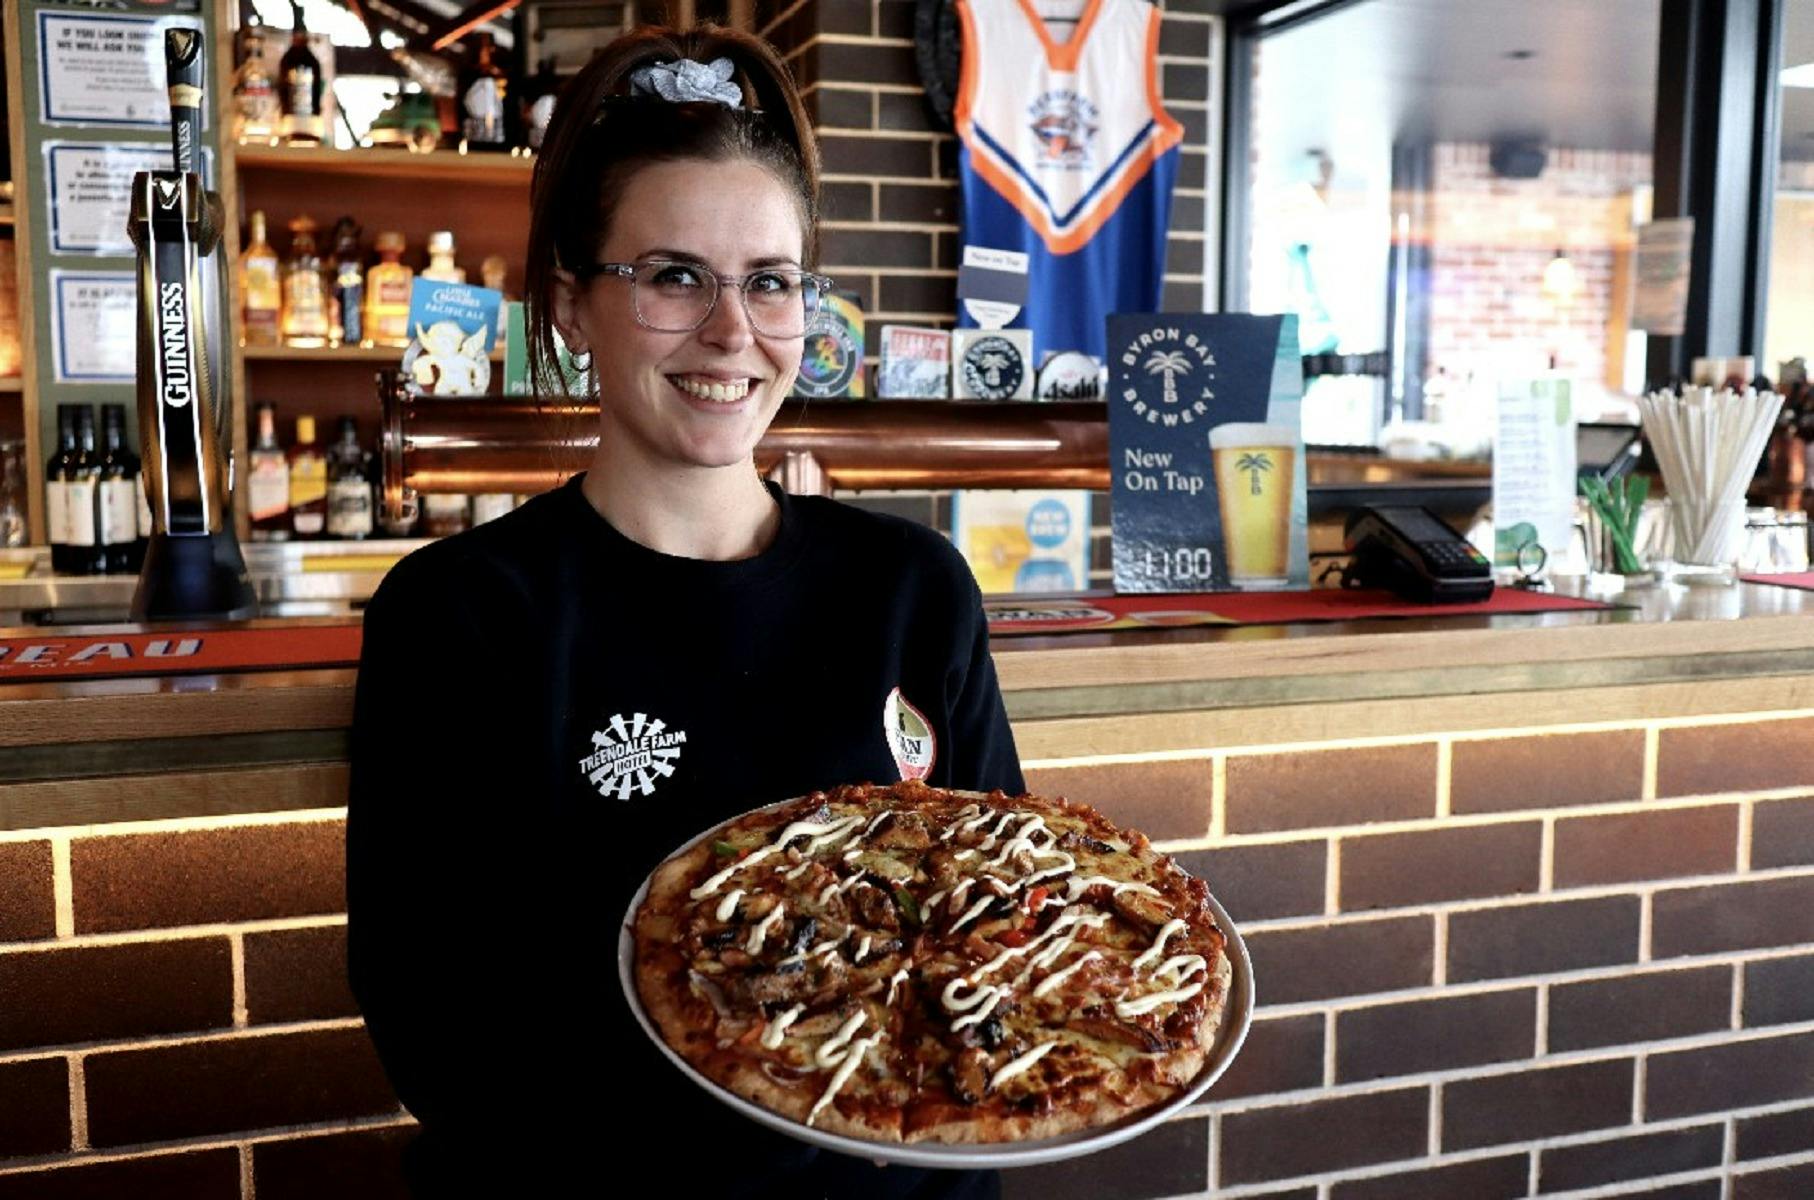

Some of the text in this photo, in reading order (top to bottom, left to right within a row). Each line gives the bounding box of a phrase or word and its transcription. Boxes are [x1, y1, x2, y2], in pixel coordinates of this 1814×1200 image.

[425, 303, 485, 321] PACIFIC ALE
[161, 282, 190, 408] GUINNESS
[1122, 328, 1216, 366] BYRON BAY
[1043, 375, 1099, 399] Asahi
[1123, 387, 1215, 427] BREWERY
[1125, 448, 1172, 468] New
[1125, 471, 1204, 496] On Tap
[579, 730, 687, 774] TREENDALE FARM
[615, 751, 651, 777] HOTEL
